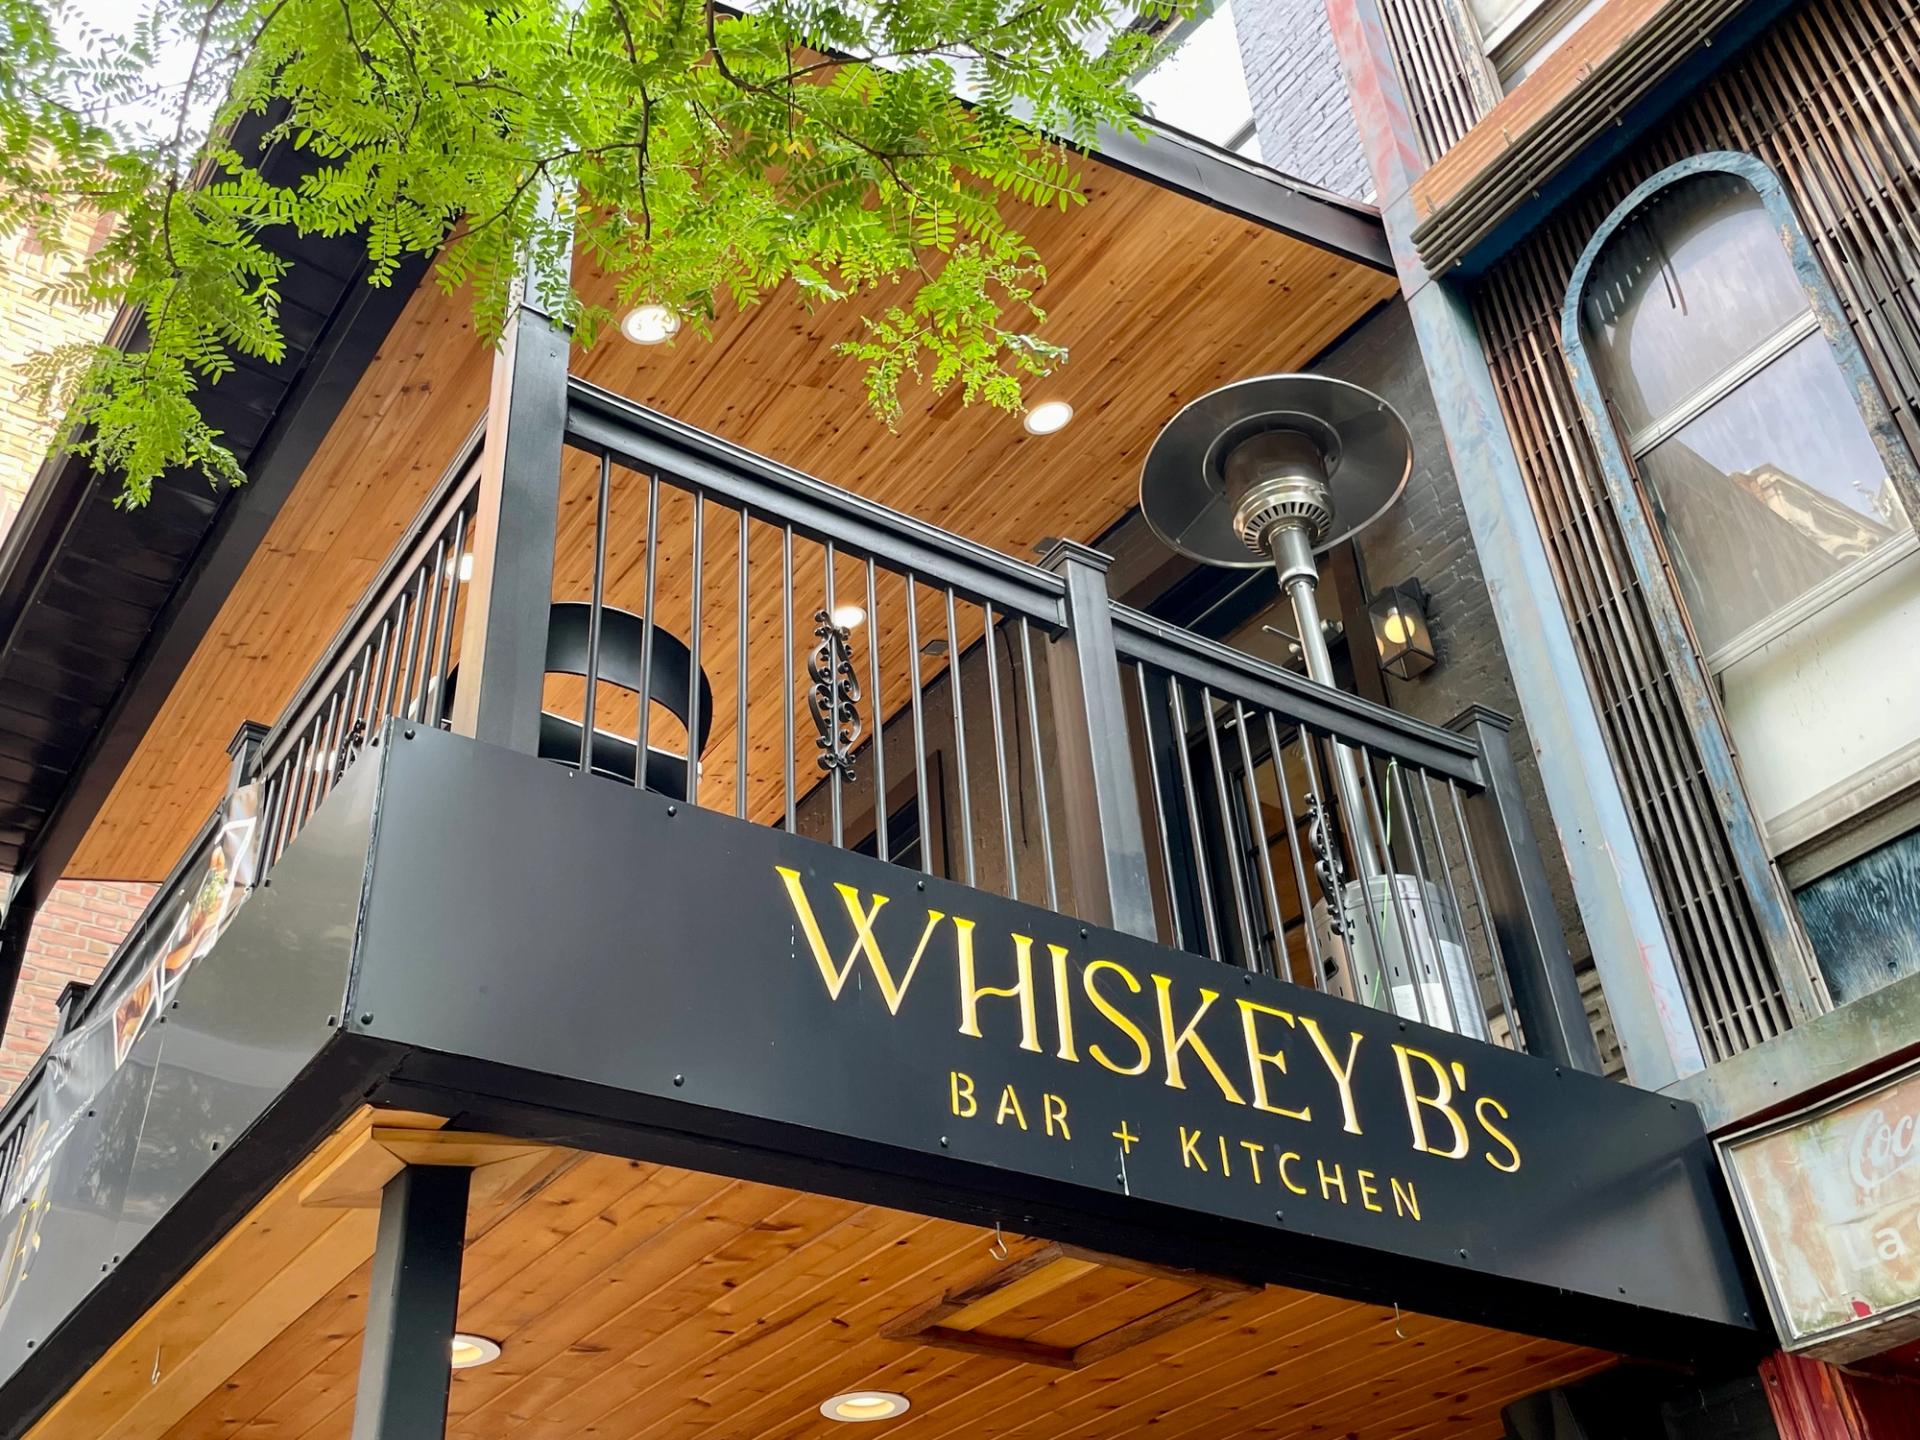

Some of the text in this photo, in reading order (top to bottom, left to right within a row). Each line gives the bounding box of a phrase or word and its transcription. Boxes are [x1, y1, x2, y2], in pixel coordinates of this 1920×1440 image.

[775, 865, 1364, 1136] WHISKEY
[950, 1071, 1072, 1140] BAR
[1179, 1126, 1420, 1221] KITCHEN
